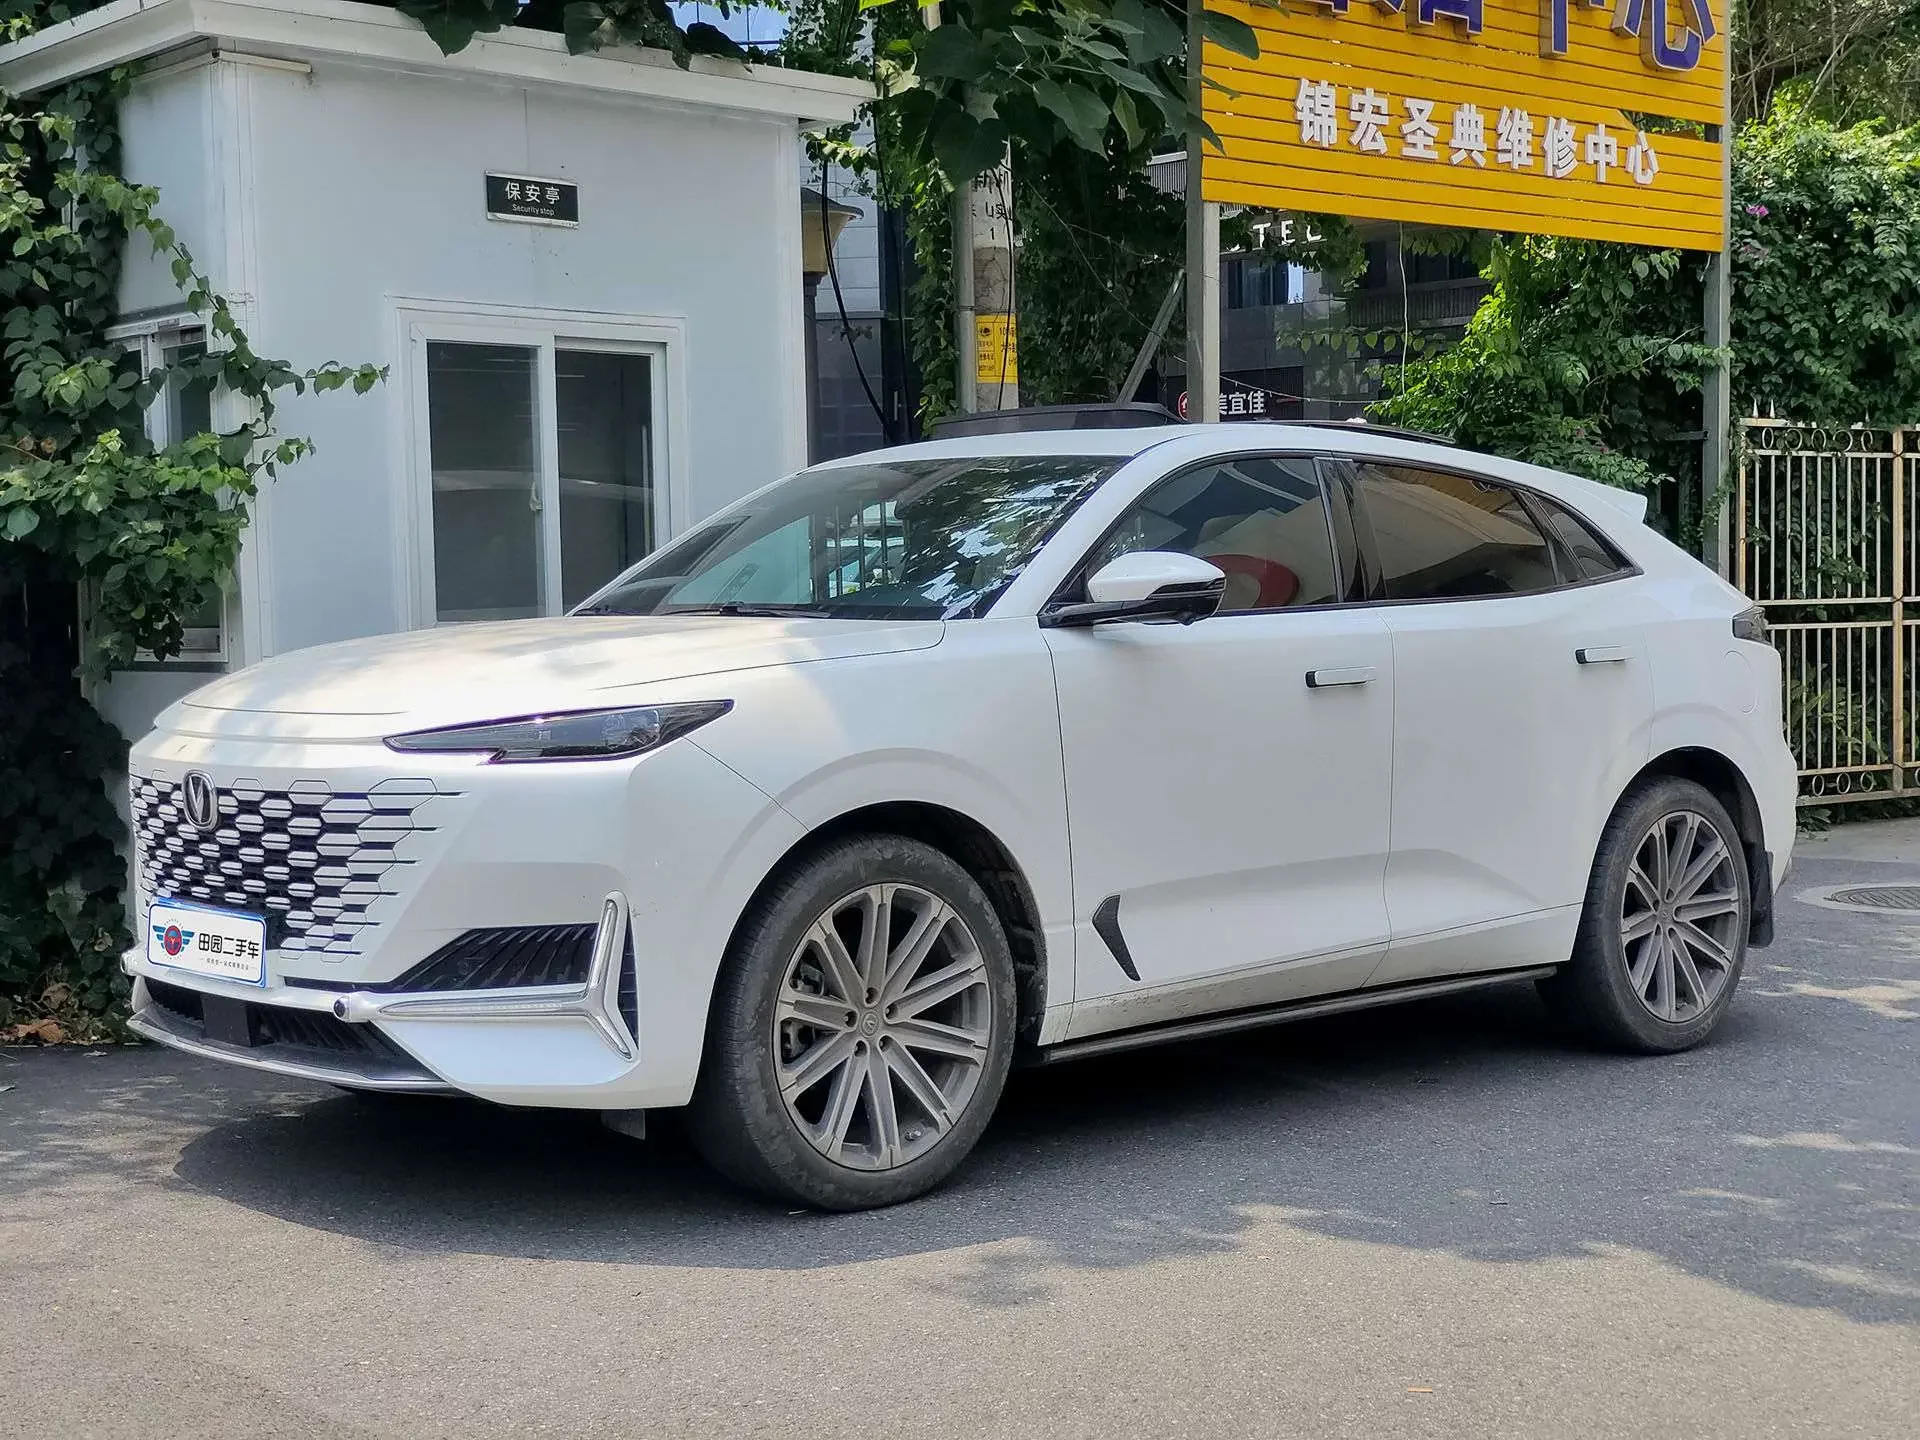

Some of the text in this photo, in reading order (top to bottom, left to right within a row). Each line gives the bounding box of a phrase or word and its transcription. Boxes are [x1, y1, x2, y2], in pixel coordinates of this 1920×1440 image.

[1295, 77, 1660, 185] 锦宏圣典维修中心
[505, 181, 560, 205] 保安亭
[512, 203, 540, 215] Security
[1226, 219, 1323, 252] TEL
[199, 933, 260, 959] 田园二手车
